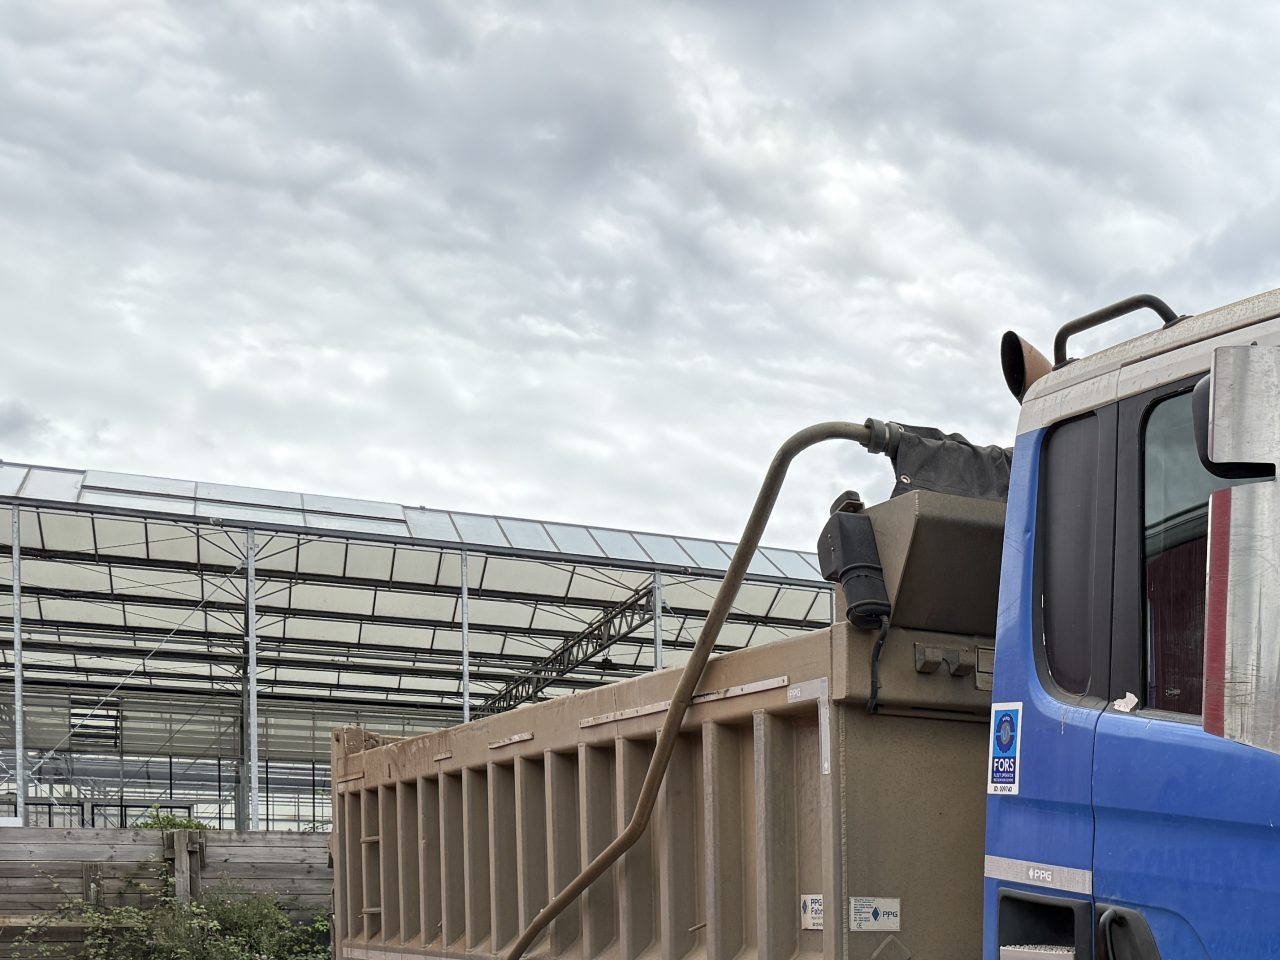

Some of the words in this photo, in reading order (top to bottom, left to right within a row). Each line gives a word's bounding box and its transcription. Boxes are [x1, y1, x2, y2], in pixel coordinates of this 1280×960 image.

[993, 758, 1014, 772] FORS
[1034, 869, 1052, 881] PPG
[810, 898, 822, 906] PPG
